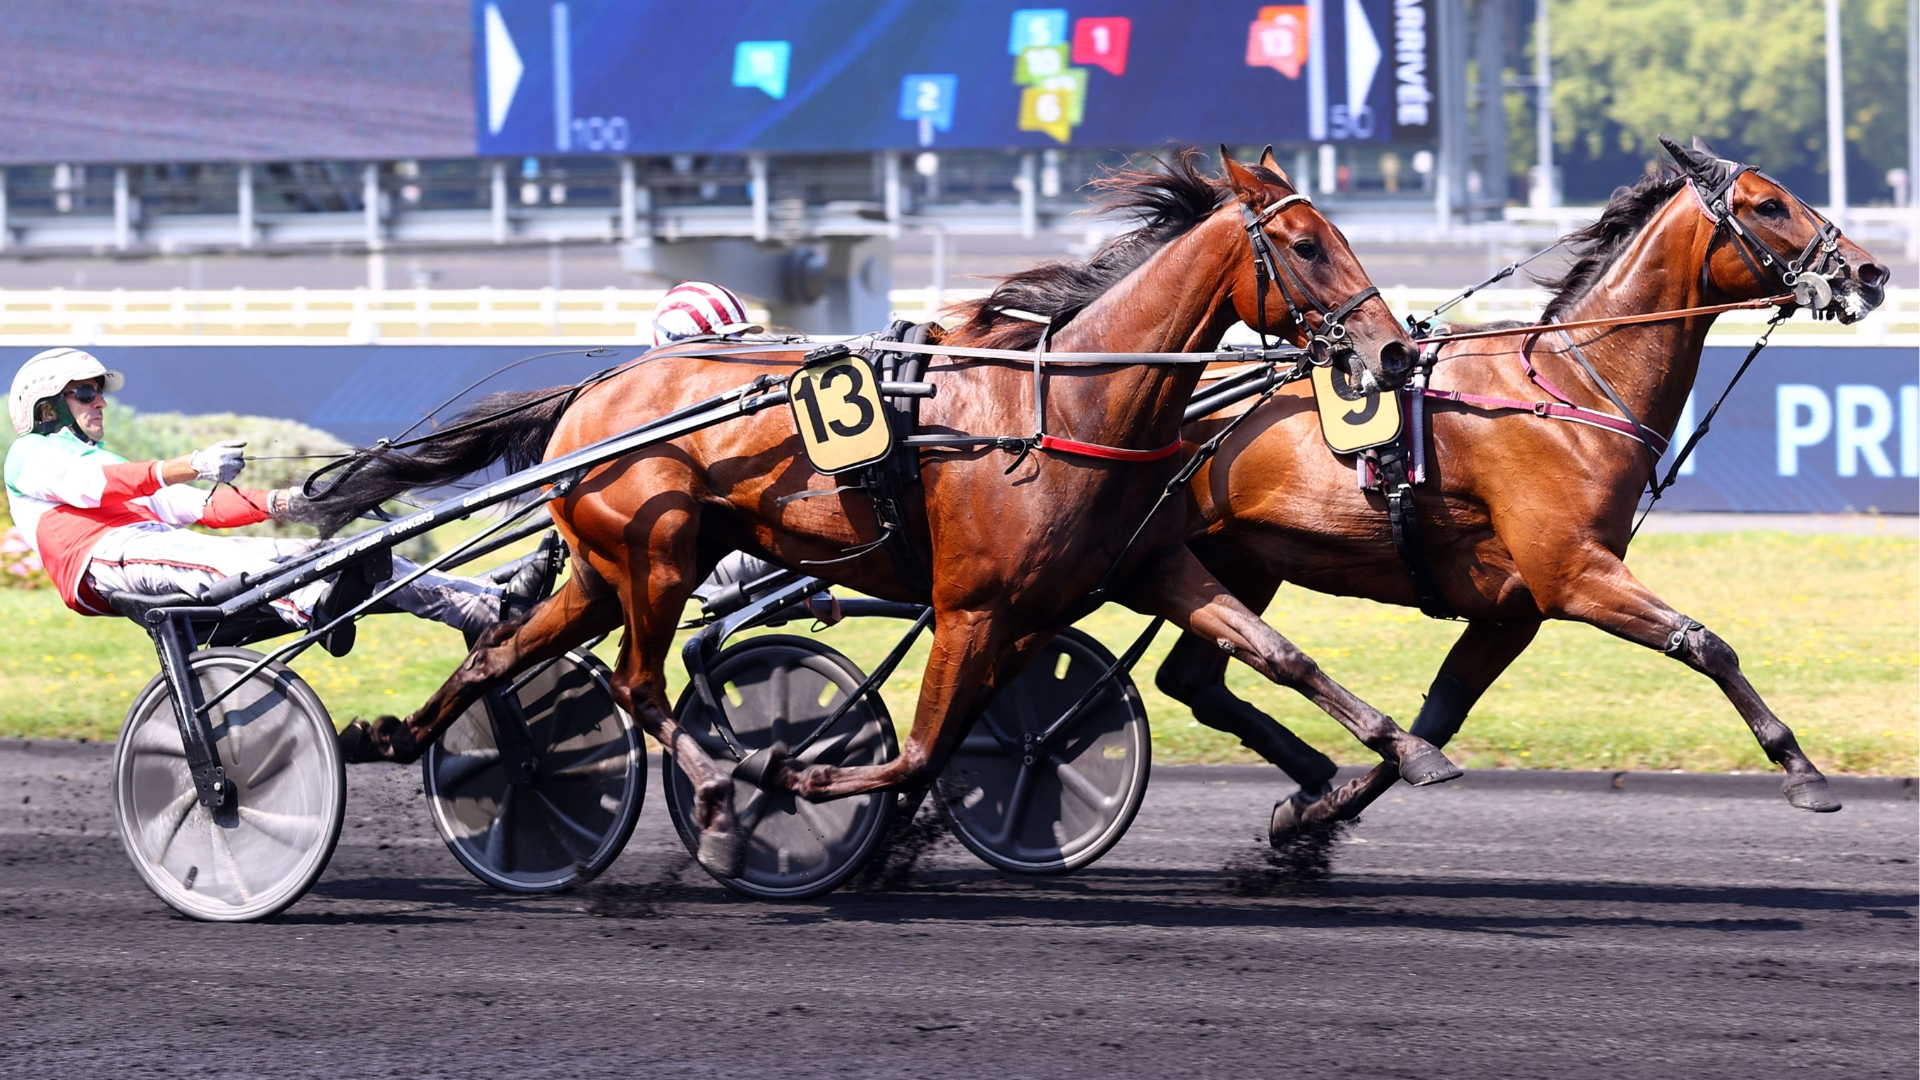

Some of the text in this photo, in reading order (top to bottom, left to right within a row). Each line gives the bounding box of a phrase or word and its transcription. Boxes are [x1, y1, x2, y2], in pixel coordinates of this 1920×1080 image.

[1091, 25, 1110, 55] 1
[917, 82, 940, 112] 2
[1036, 93, 1062, 123] 6
[571, 116, 630, 151] 100
[1329, 103, 1375, 140] 50
[794, 364, 875, 444] 13
[1331, 366, 1381, 426] 9
[315, 510, 435, 572] CUSTOM YONKERS
